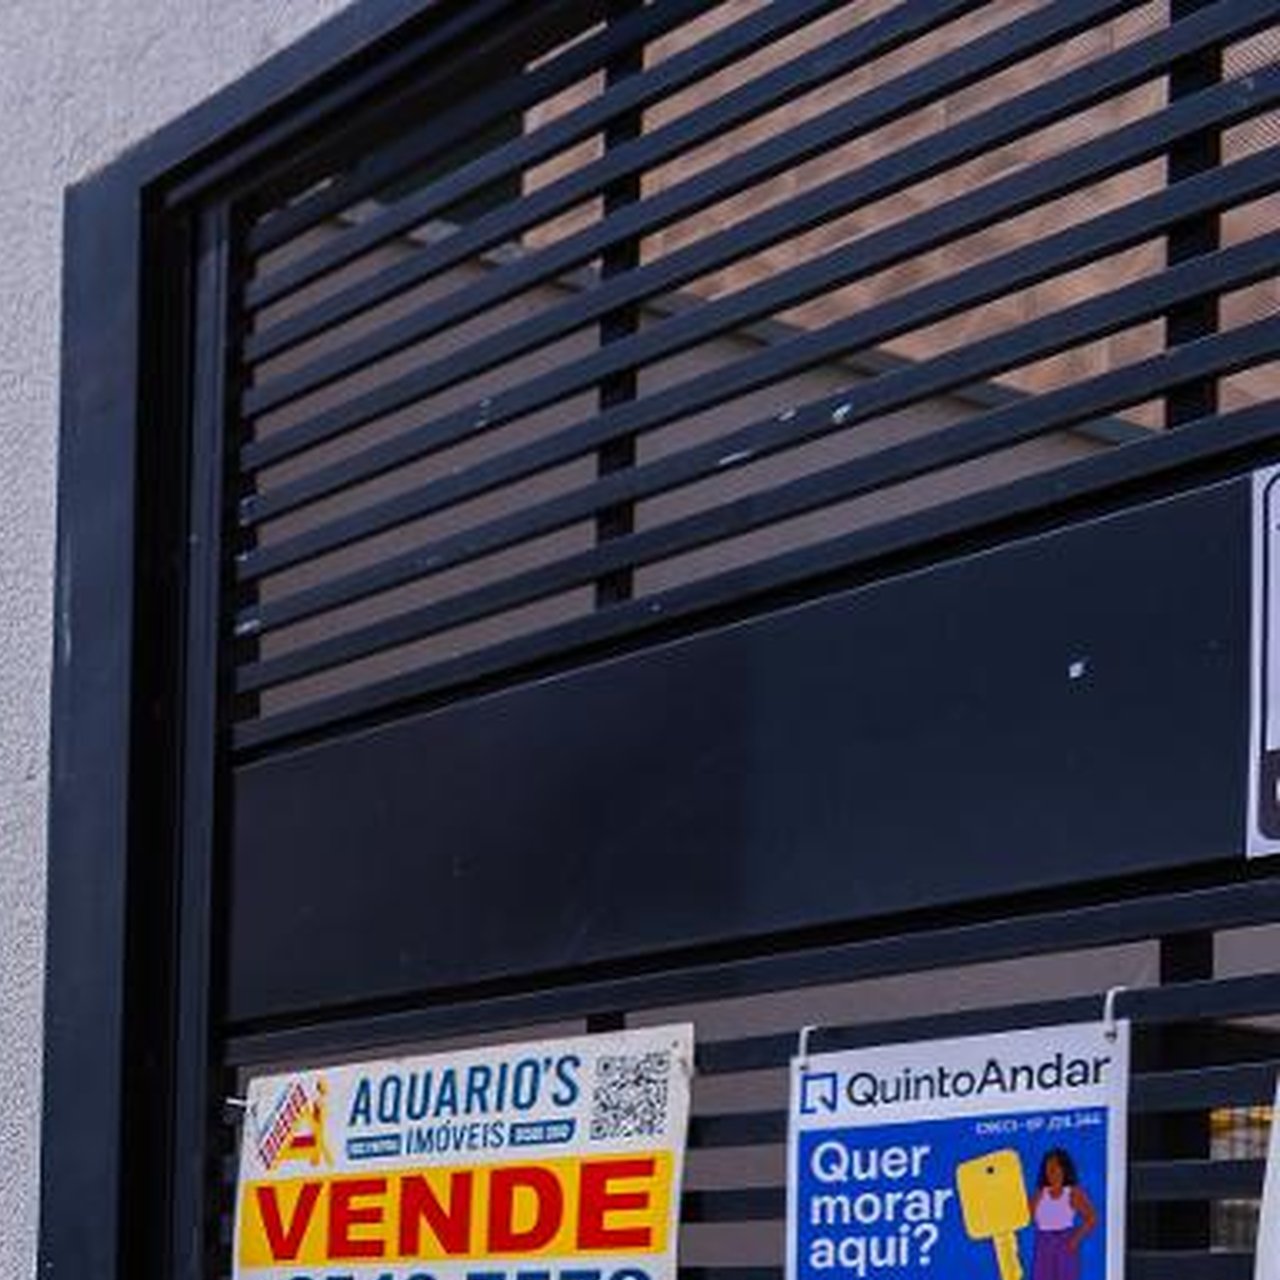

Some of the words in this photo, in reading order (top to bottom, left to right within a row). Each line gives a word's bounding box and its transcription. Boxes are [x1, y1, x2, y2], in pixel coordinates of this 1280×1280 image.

[348, 1055, 582, 1126] AQUARIO'S
[846, 1053, 1112, 1107] QuintoAndar
[406, 1118, 506, 1155] IMÓVEIS
[810, 1141, 930, 1183] Quer
[256, 1159, 656, 1262] VENDE
[810, 1187, 953, 1225] morar
[809, 1223, 939, 1278] aqui?
